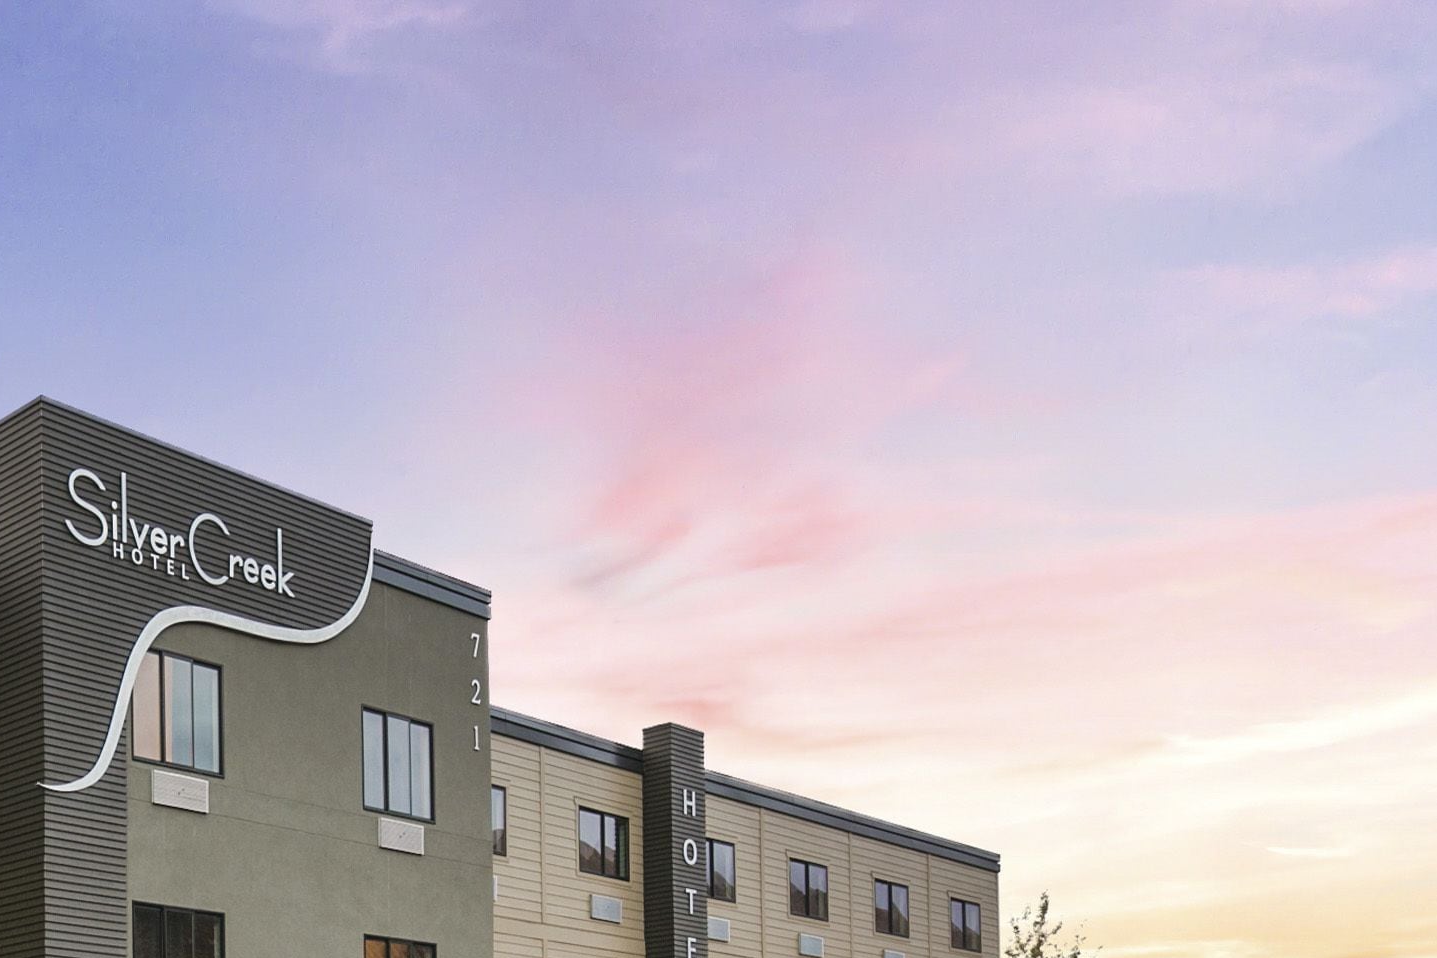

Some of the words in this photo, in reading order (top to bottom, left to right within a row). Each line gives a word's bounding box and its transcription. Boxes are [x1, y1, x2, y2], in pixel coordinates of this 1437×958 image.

[65, 468, 185, 558] Silver
[188, 513, 295, 598] Creek
[112, 542, 190, 580] HOTEL
